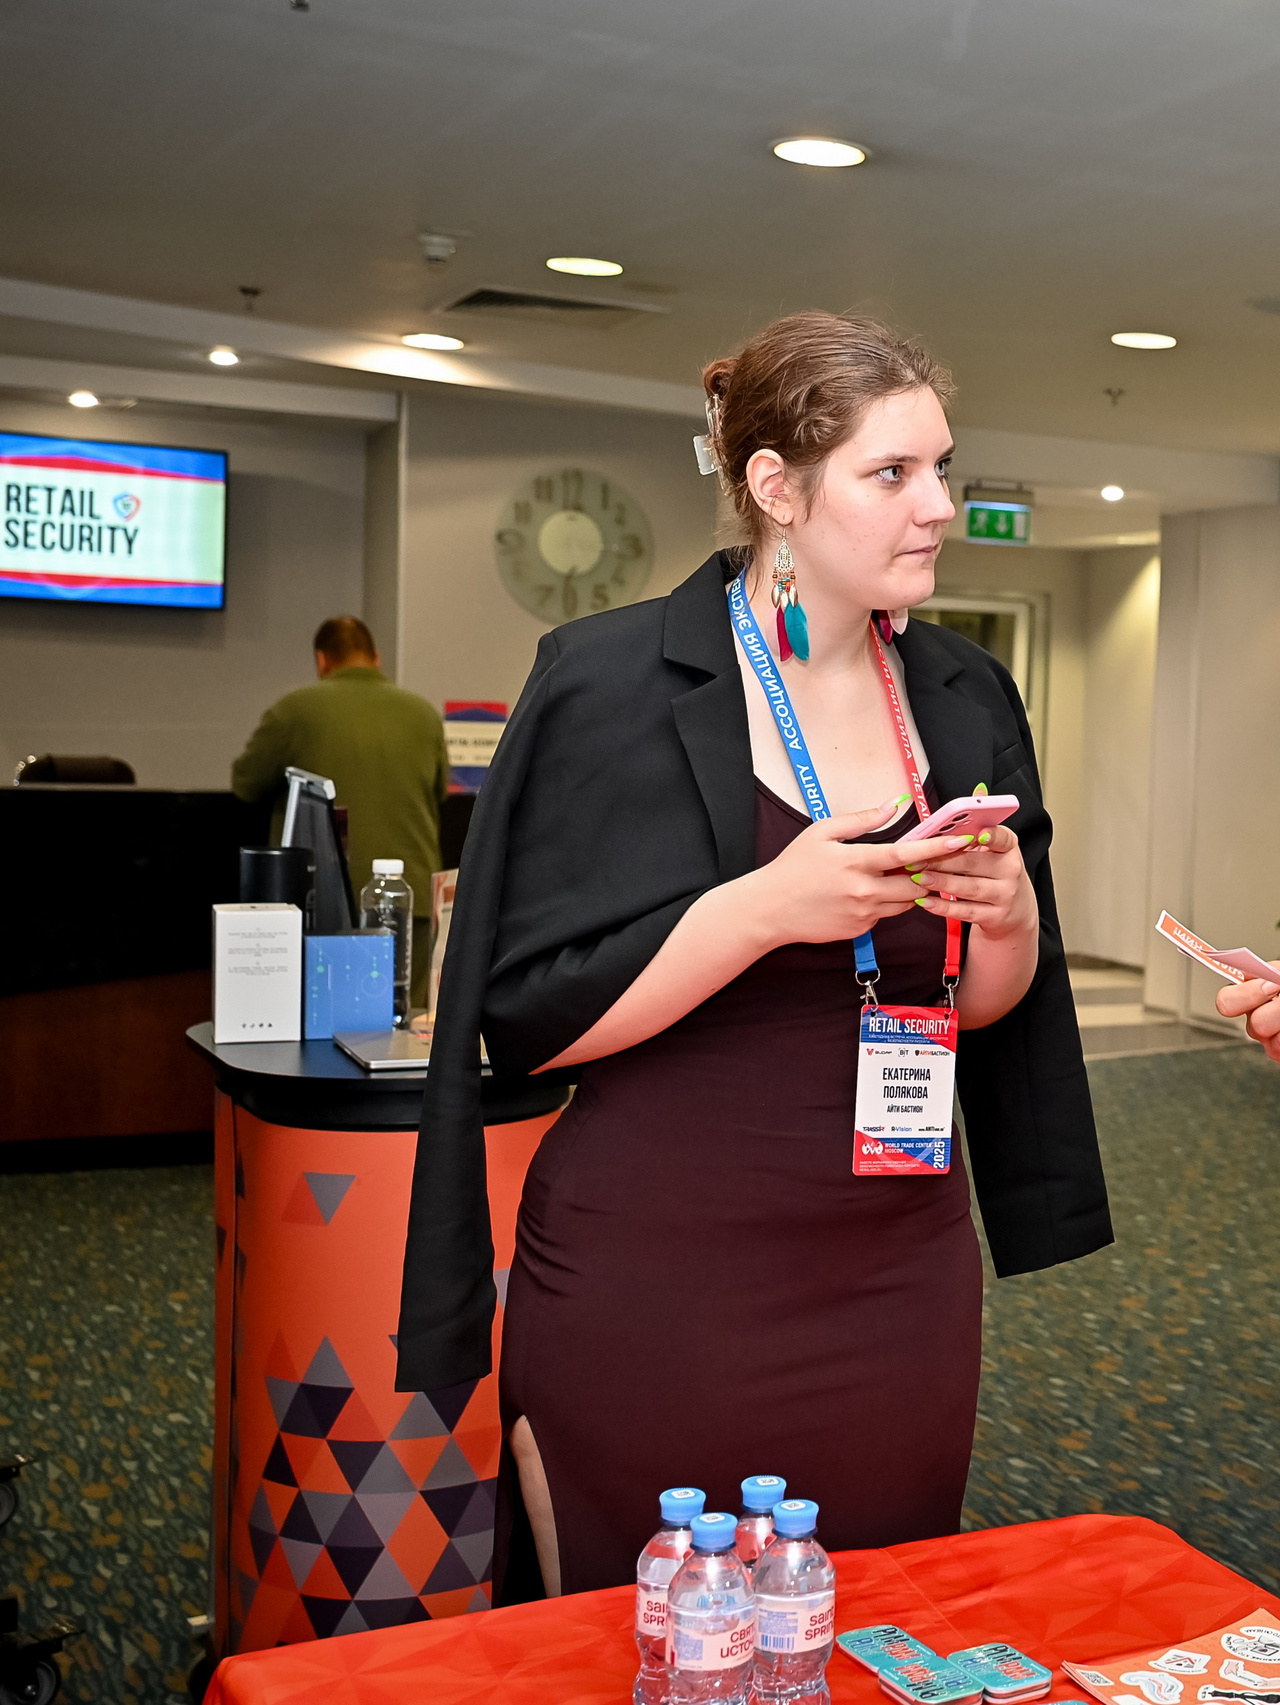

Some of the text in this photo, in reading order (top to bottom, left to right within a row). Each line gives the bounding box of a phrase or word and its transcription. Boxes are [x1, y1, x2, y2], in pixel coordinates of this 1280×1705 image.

[5, 483, 101, 520] RETAIL
[4, 519, 139, 555] SECURITY
[743, 631, 803, 751] АССОЦИАЦИЯ
[796, 763, 832, 822] CURITY
[911, 772, 931, 821] RETAI
[868, 1017, 950, 1035] RETAIL SECURITY
[882, 1067, 931, 1081] ЕКАТЕРИНА
[883, 1085, 929, 1099] ПОЛЯКОВА
[886, 1104, 923, 1113] АЙТИ БАСТИОН
[933, 1141, 946, 1169] 2025
